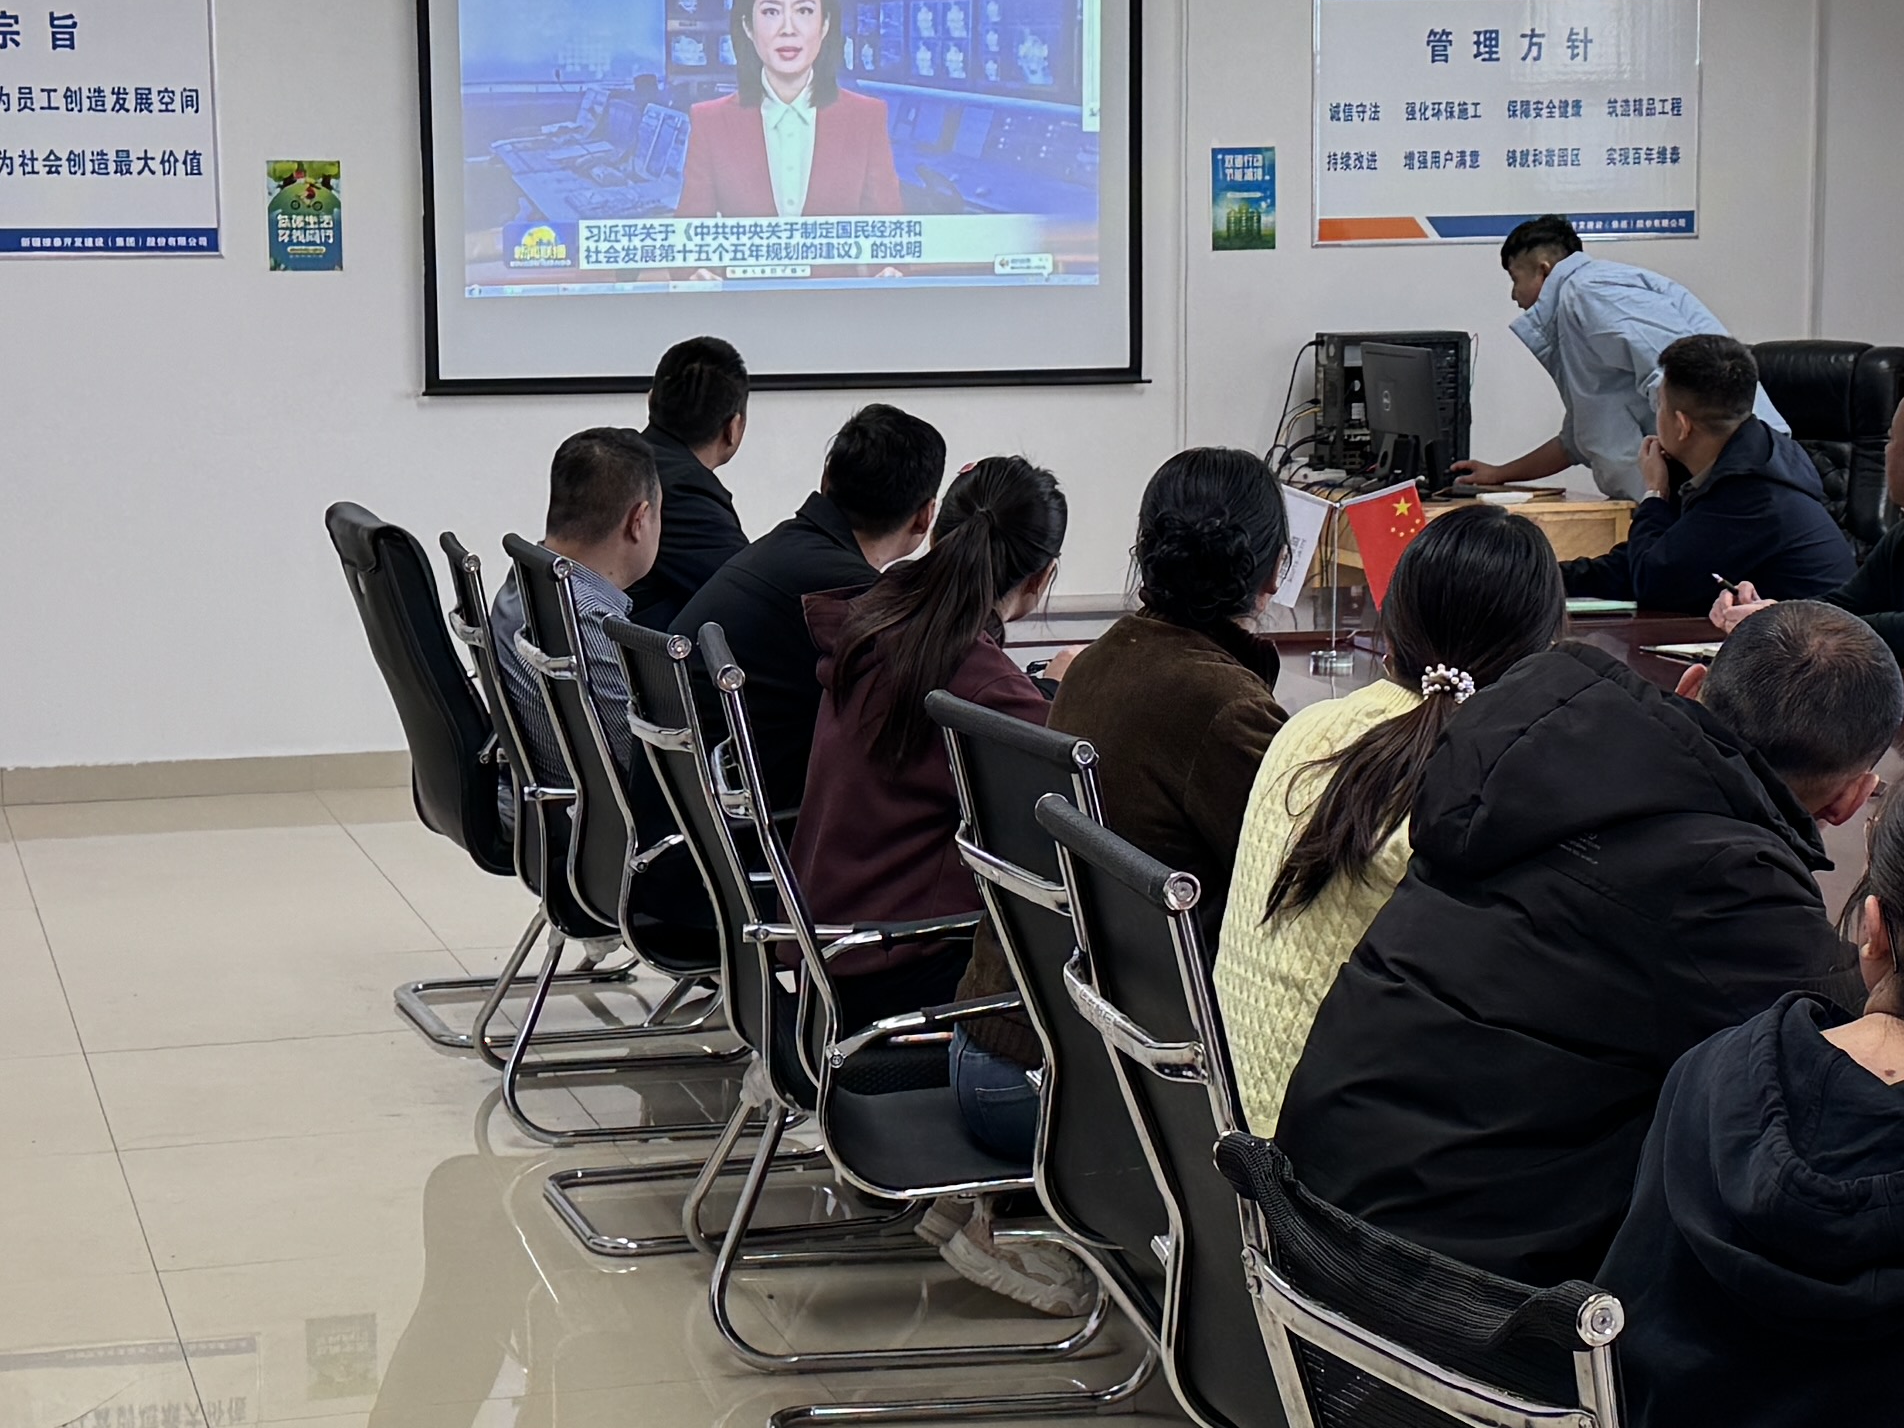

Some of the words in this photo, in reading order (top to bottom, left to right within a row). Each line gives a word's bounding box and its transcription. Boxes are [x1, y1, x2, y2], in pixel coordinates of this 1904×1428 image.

[1425, 26, 1594, 64] 管理方针
[1328, 101, 1381, 122] 诚信守法
[1404, 100, 1482, 121] 强化环保施工
[1507, 98, 1583, 119] 保障安全健康
[1606, 97, 1683, 118] 筑造精品工程
[1326, 150, 1378, 171] 持续改进
[1403, 149, 1481, 170] 增强用户满意
[1605, 145, 1681, 166] 实现百年维泰
[583, 220, 923, 244] 习近平关于《中共中央关于制定国民经济和
[583, 240, 923, 265] 社会发展第十五个五年规划的建议》的说明
